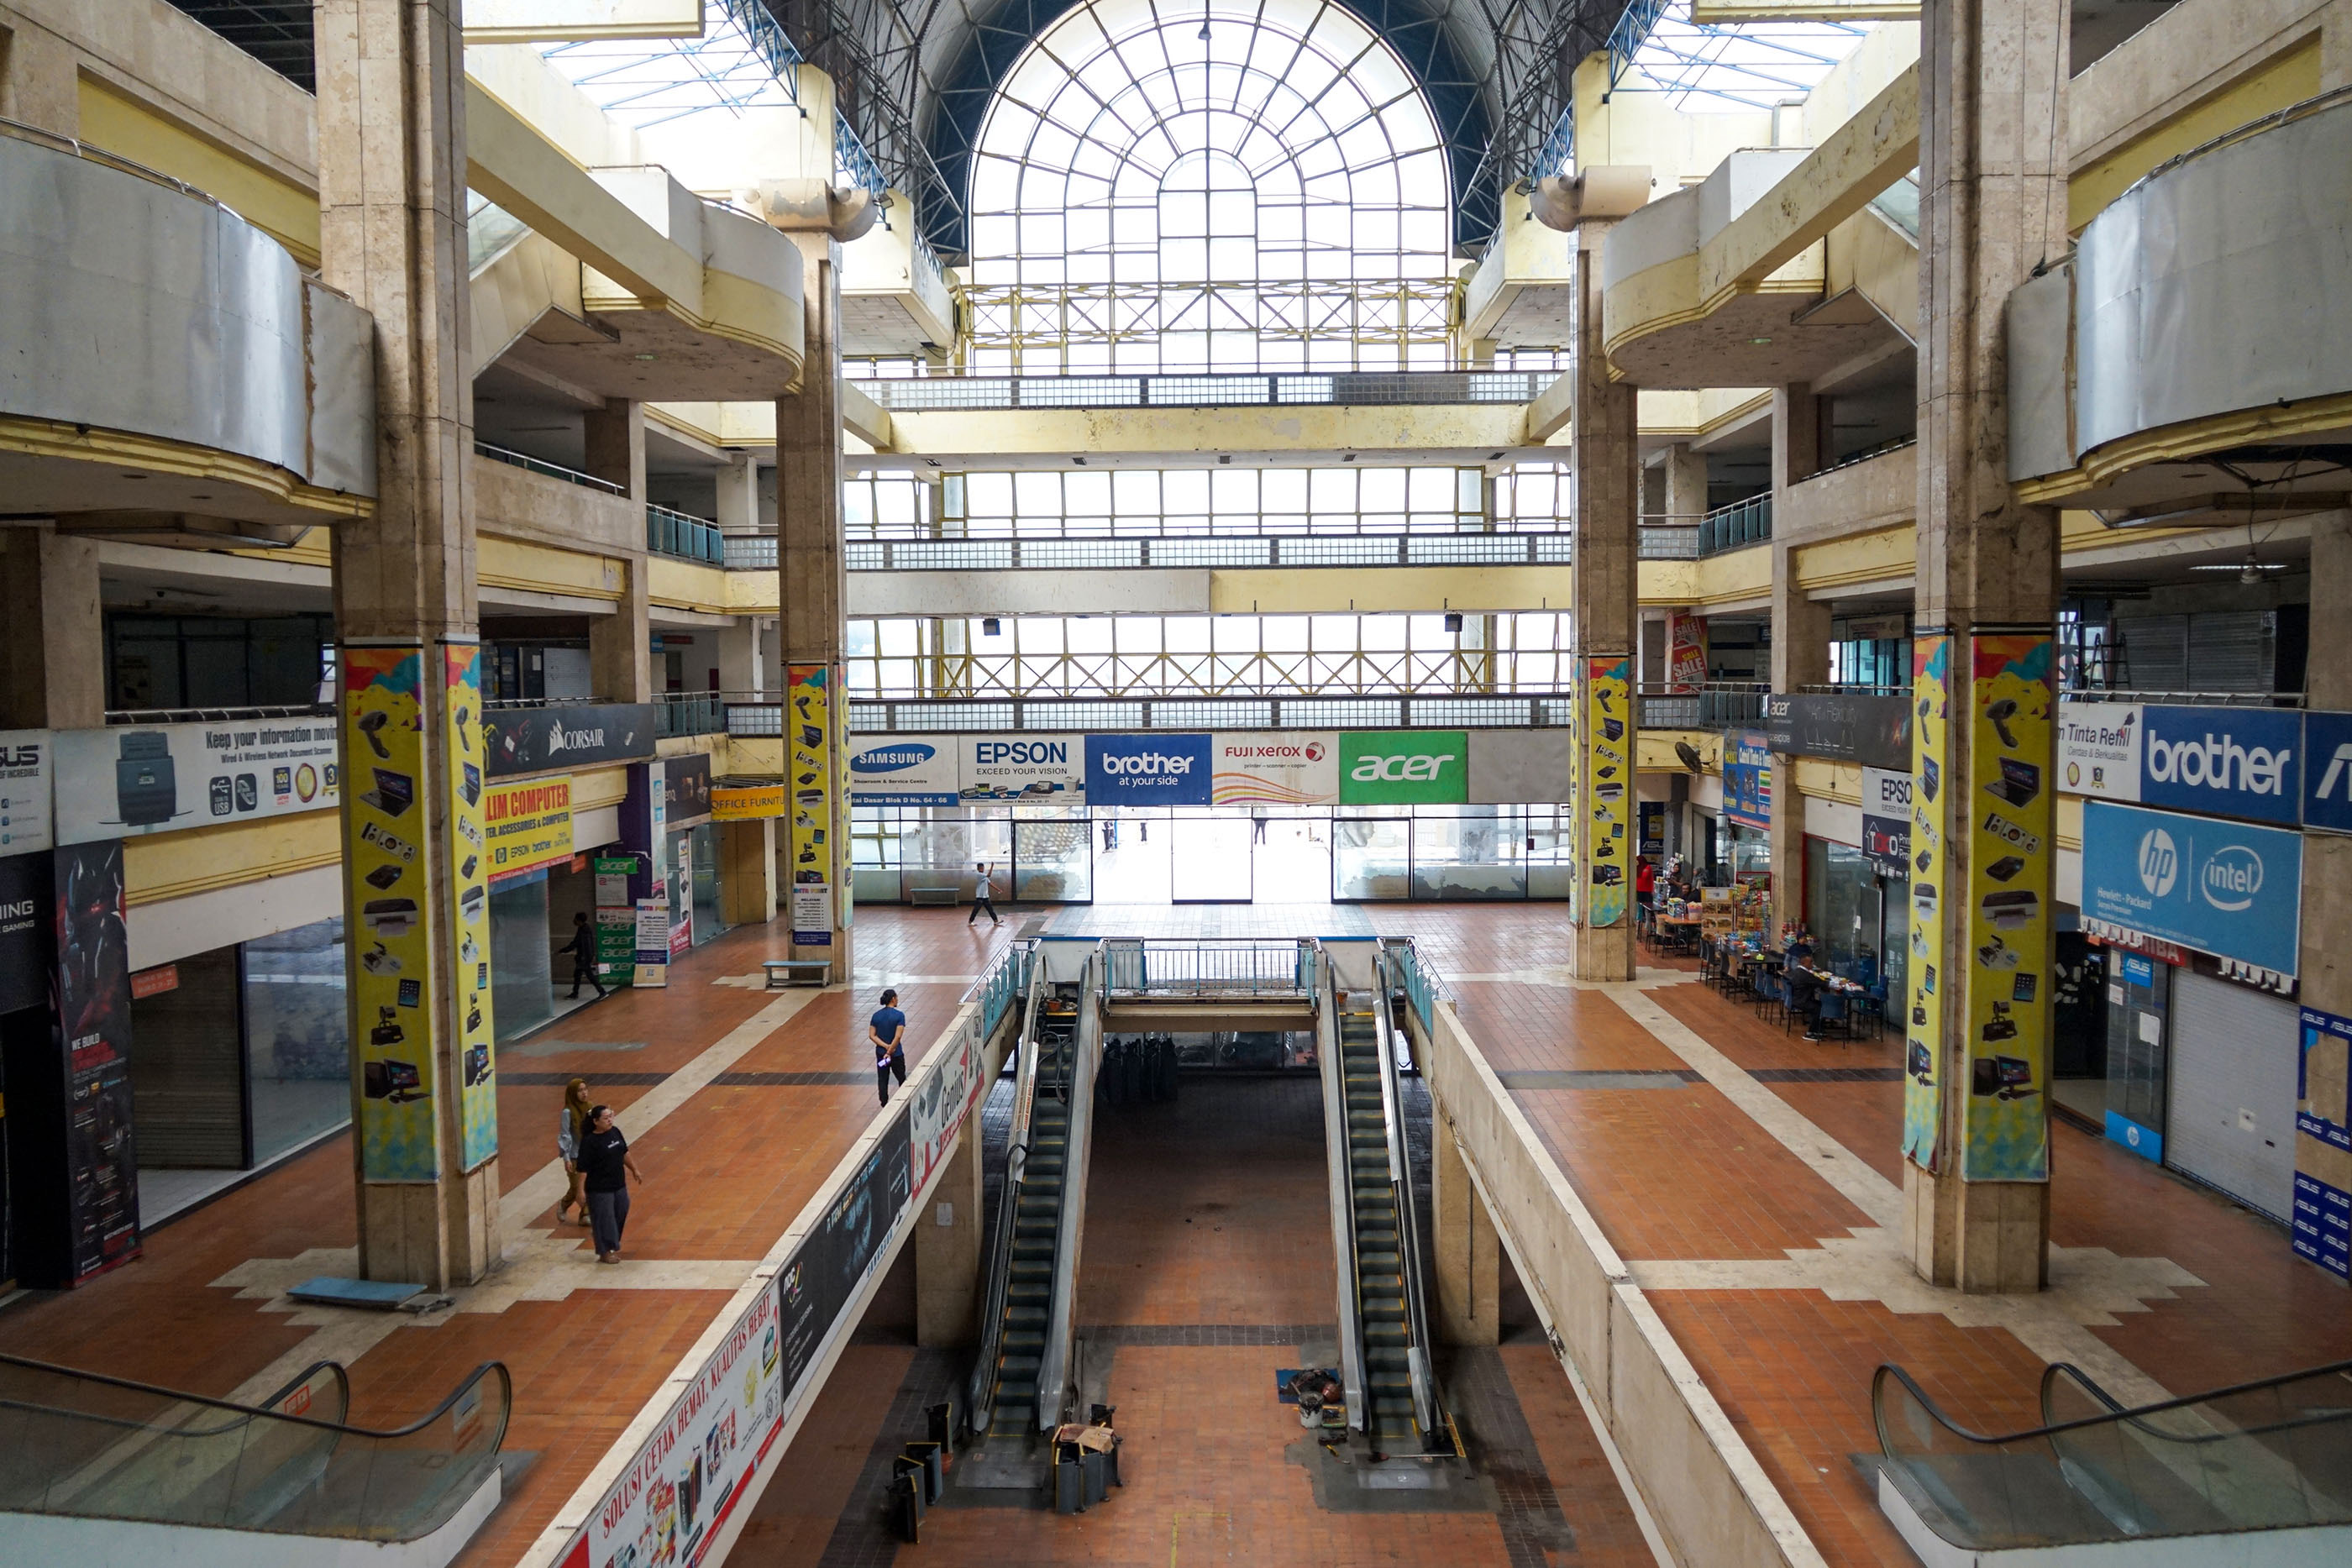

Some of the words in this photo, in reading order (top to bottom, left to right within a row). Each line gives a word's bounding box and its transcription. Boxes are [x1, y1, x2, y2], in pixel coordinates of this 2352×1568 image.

[1674, 622, 1697, 636] SALE
[1673, 658, 1704, 678] SALE
[1771, 701, 1790, 716] acer
[206, 731, 230, 750] Keep
[234, 732, 256, 749] your
[260, 726, 311, 745] information
[314, 724, 338, 741] movin
[564, 728, 605, 750] CORSAIR
[2069, 723, 2097, 742] Tinta
[2100, 727, 2131, 747] Refill
[221, 755, 236, 763] Wired
[244, 753, 266, 761] Wireless
[268, 750, 288, 759] Network
[290, 748, 312, 758] Document
[314, 747, 333, 755] Scanner
[859, 753, 924, 763] SAMSUNG
[976, 742, 1067, 764] EPSON
[1226, 747, 1252, 757] FUJI
[1257, 747, 1300, 757] xerox
[1103, 752, 1194, 774] brother
[1351, 755, 1454, 781] acer
[2148, 729, 2292, 795] brother
[8, 768, 39, 779] INCREDIBLE
[328, 768, 334, 783] 3
[1119, 777, 1130, 785] at
[1132, 777, 1156, 788] your
[1157, 775, 1179, 785] side
[664, 789, 676, 803] enQ
[1882, 779, 1913, 805] EPSO
[215, 802, 229, 814] USB
[486, 794, 507, 821] LIM
[511, 784, 569, 817] COMPUTER
[712, 800, 746, 810] OFFICE
[750, 796, 784, 807] FURNITU
[1882, 804, 1896, 813] EXCEED
[498, 819, 536, 836] ACCESSORIES
[542, 812, 569, 826] COMPUTER
[1899, 833, 1911, 845] Prin
[511, 845, 529, 857] EPSON
[1899, 849, 1911, 861] Proj
[599, 861, 632, 870] acer
[2139, 828, 2177, 897] hp
[2209, 857, 2254, 894] intel
[2097, 887, 2122, 901] Hewlett
[2126, 894, 2152, 910] Packard
[3, 920, 34, 933] GAMING
[601, 936, 634, 945] acer
[602, 948, 634, 957] acer
[610, 962, 635, 972] cer
[2127, 958, 2150, 973] ASUS
[2302, 1012, 2325, 1025] ASUS
[71, 1039, 81, 1051] WE
[82, 1033, 100, 1048] BUILD
[941, 1070, 963, 1129] Genius
[2298, 1119, 2322, 1134] ASUS
[2296, 1178, 2320, 1194] ASUS
[2324, 1191, 2349, 1209] ASUS
[2295, 1198, 2318, 1215] ASUS
[2323, 1213, 2349, 1230] ASUS
[2294, 1219, 2318, 1236] ASUS
[2323, 1234, 2348, 1251] ASUS
[2293, 1240, 2317, 1256] ASUS
[2323, 1255, 2347, 1272] ASUS
[783, 1266, 795, 1294] AOC
[603, 1465, 641, 1539] SOLUSI
[645, 1424, 675, 1481] CETAK
[677, 1378, 709, 1437] HEMAT,
[710, 1324, 747, 1392] KUALITAS
[748, 1293, 770, 1340] HEBAT
